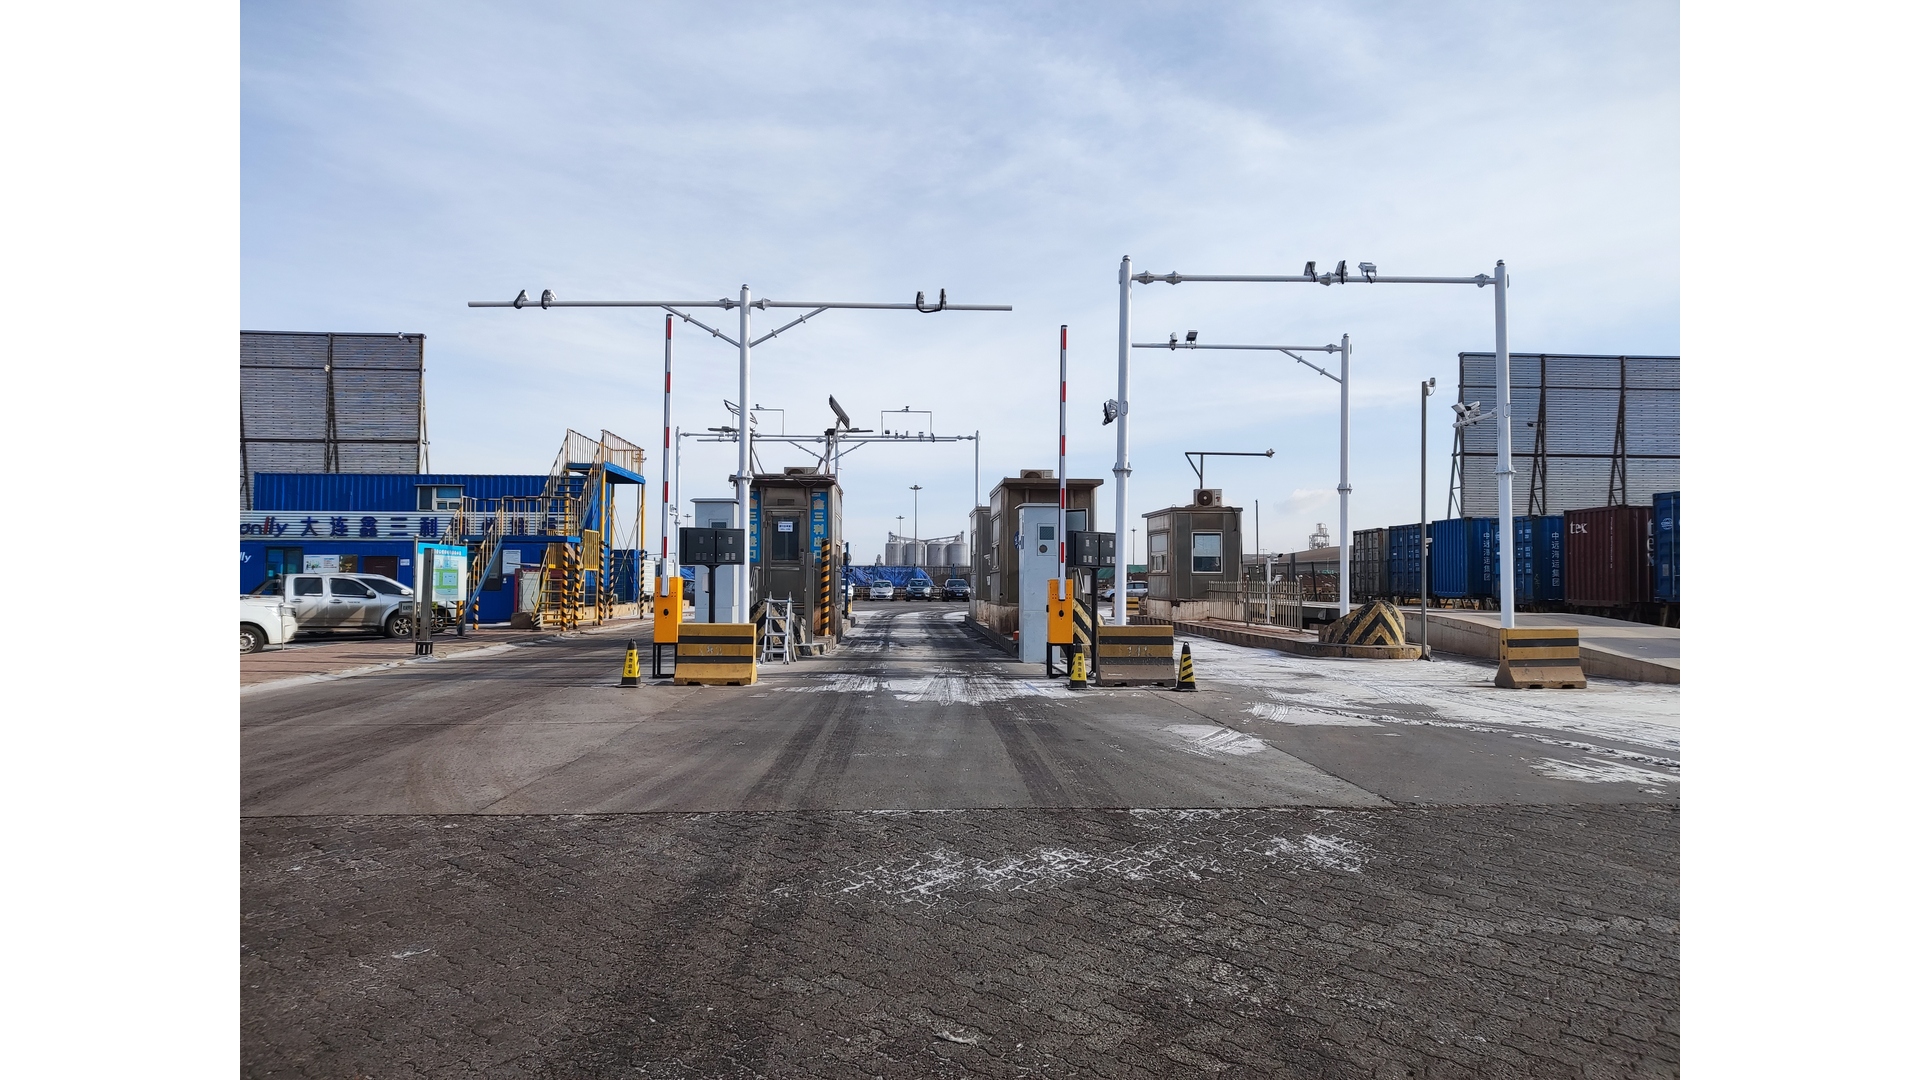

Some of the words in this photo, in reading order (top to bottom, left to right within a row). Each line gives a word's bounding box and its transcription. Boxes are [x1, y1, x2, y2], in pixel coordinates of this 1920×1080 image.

[1570, 521, 1588, 534] tex
[1551, 531, 1560, 587] 中远海运集团
